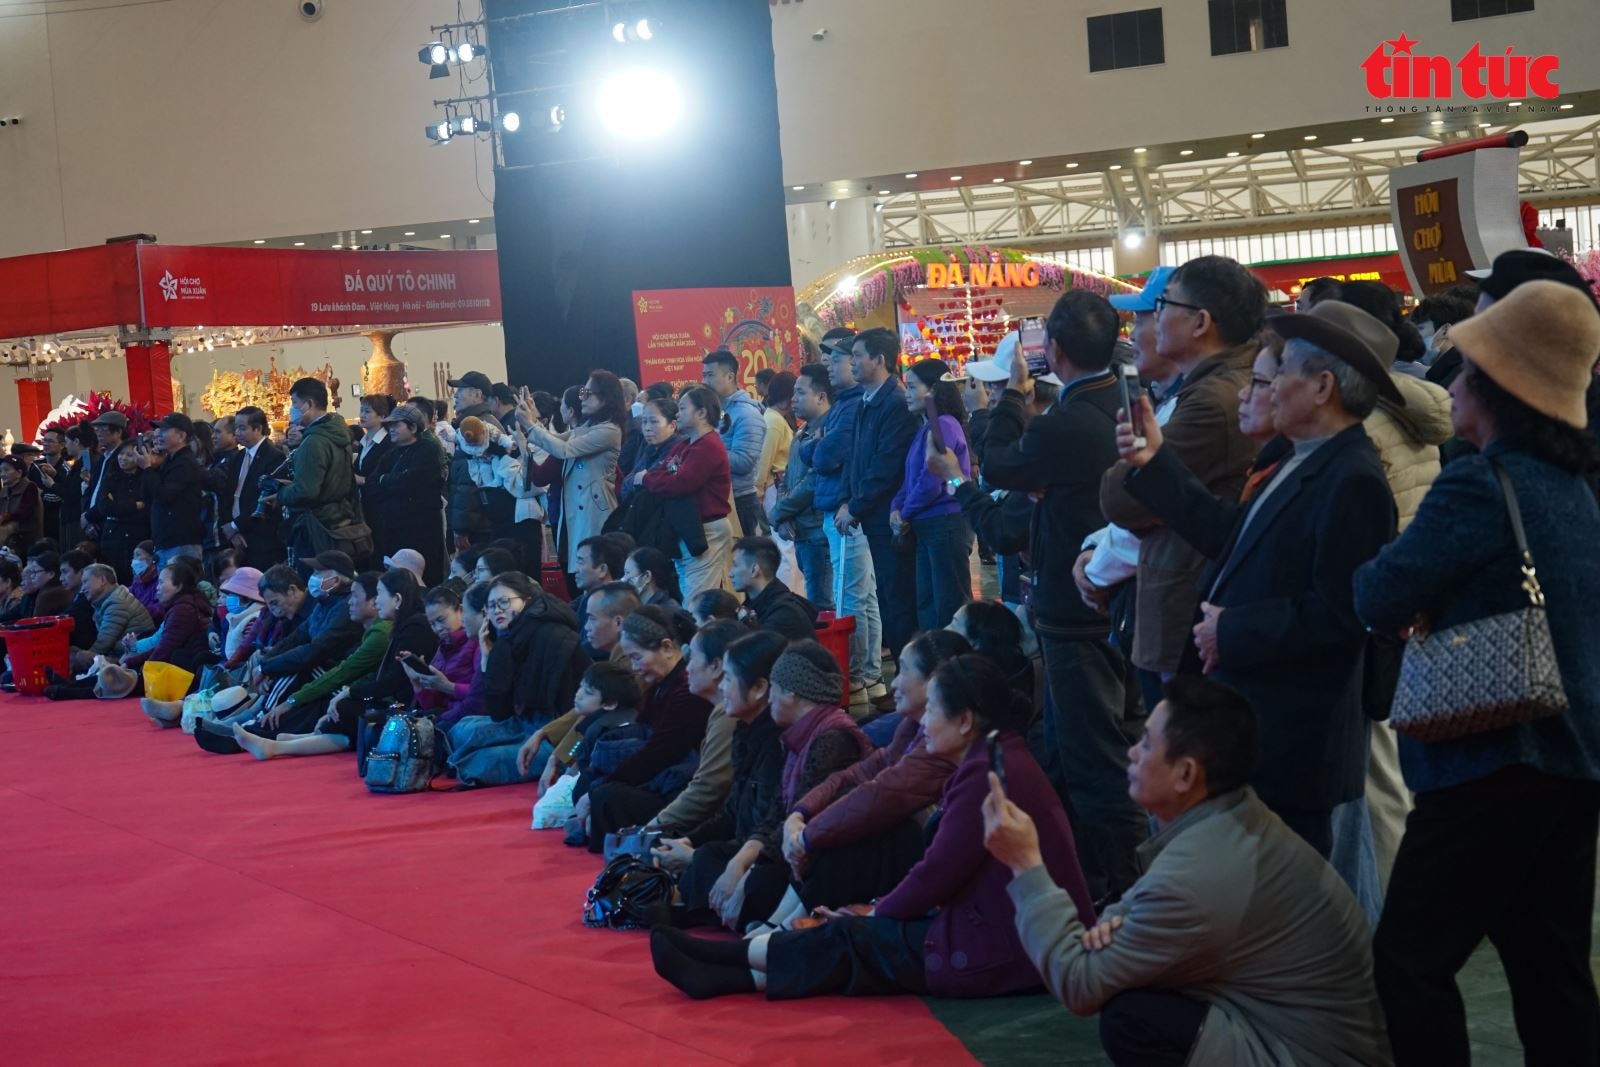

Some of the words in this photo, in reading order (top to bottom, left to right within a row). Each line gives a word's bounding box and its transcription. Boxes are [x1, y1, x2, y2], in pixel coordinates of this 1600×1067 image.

[345, 270, 365, 292] ĐÁ
[366, 270, 393, 292] QUÝ
[396, 270, 415, 291] TÔ
[417, 274, 457, 290] CHINH
[927, 254, 964, 289] ĐÀ
[311, 303, 318, 312] 19
